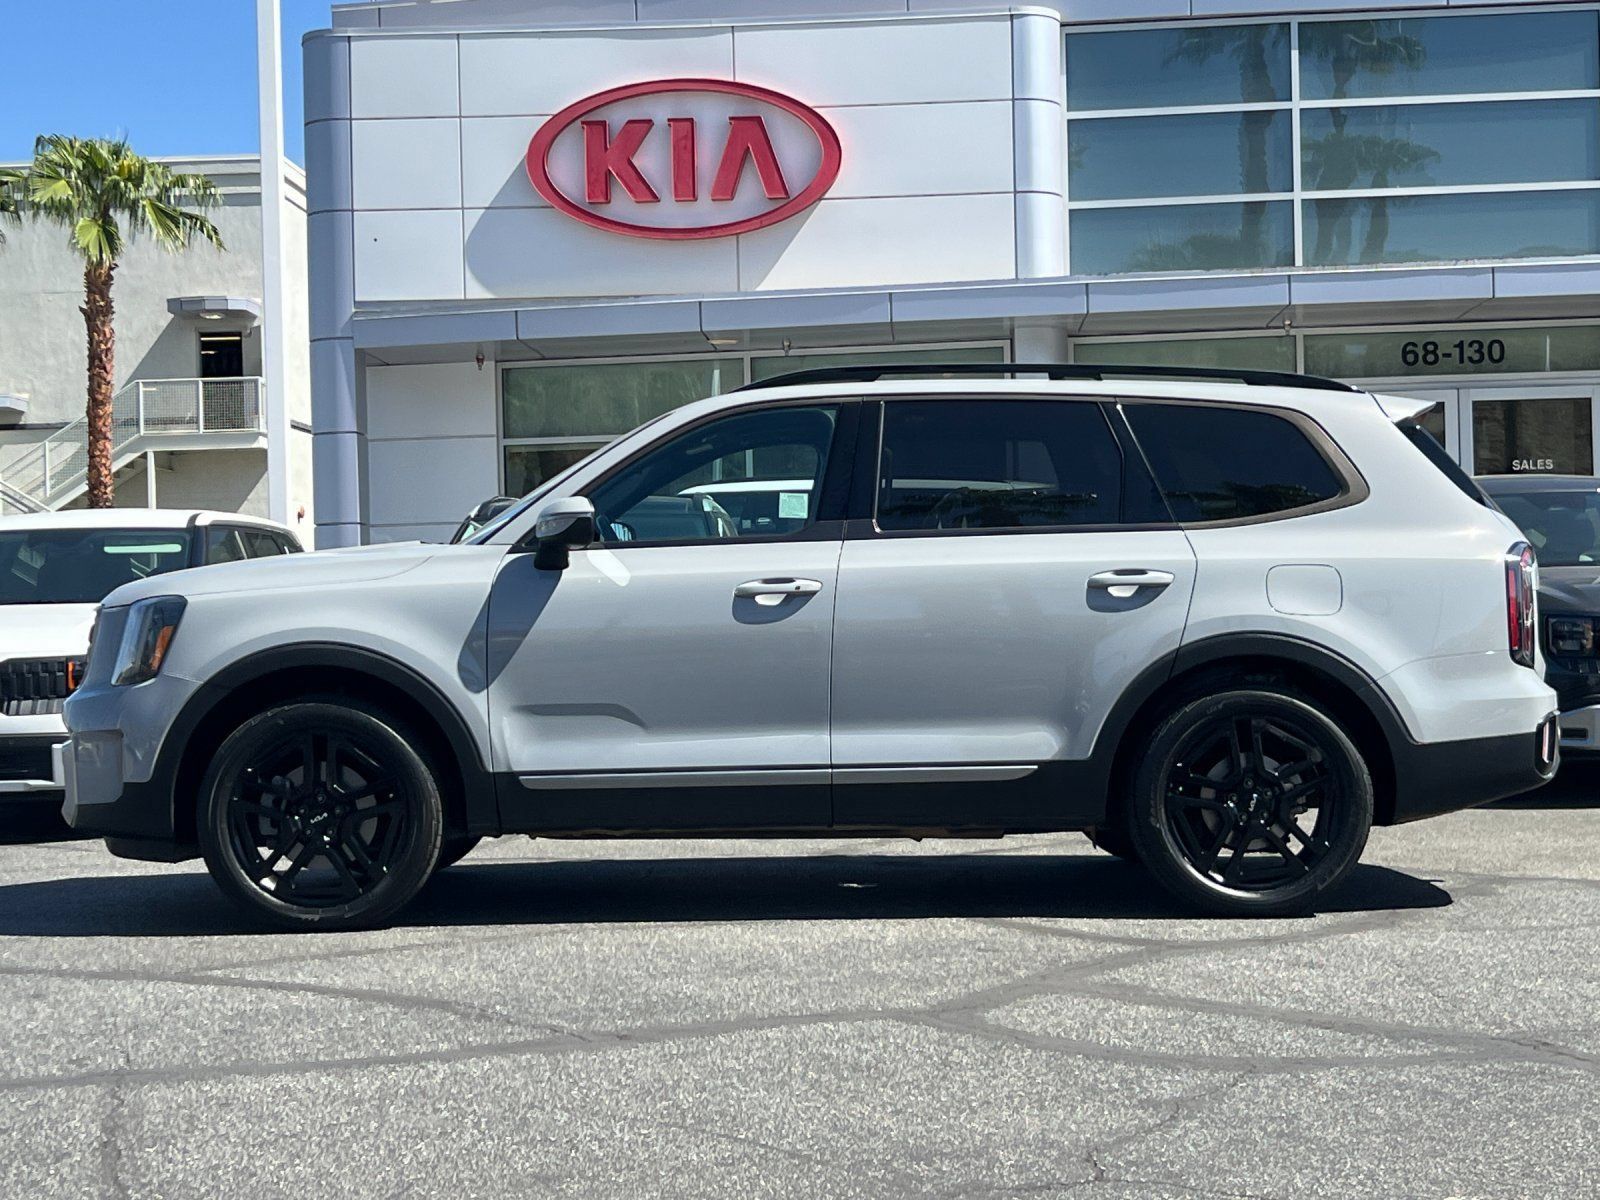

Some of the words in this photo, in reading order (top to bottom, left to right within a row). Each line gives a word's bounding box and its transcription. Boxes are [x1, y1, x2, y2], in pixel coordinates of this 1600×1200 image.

[580, 115, 790, 203] KIA
[1401, 339, 1505, 367] 68-130
[1512, 459, 1554, 471] SALES
